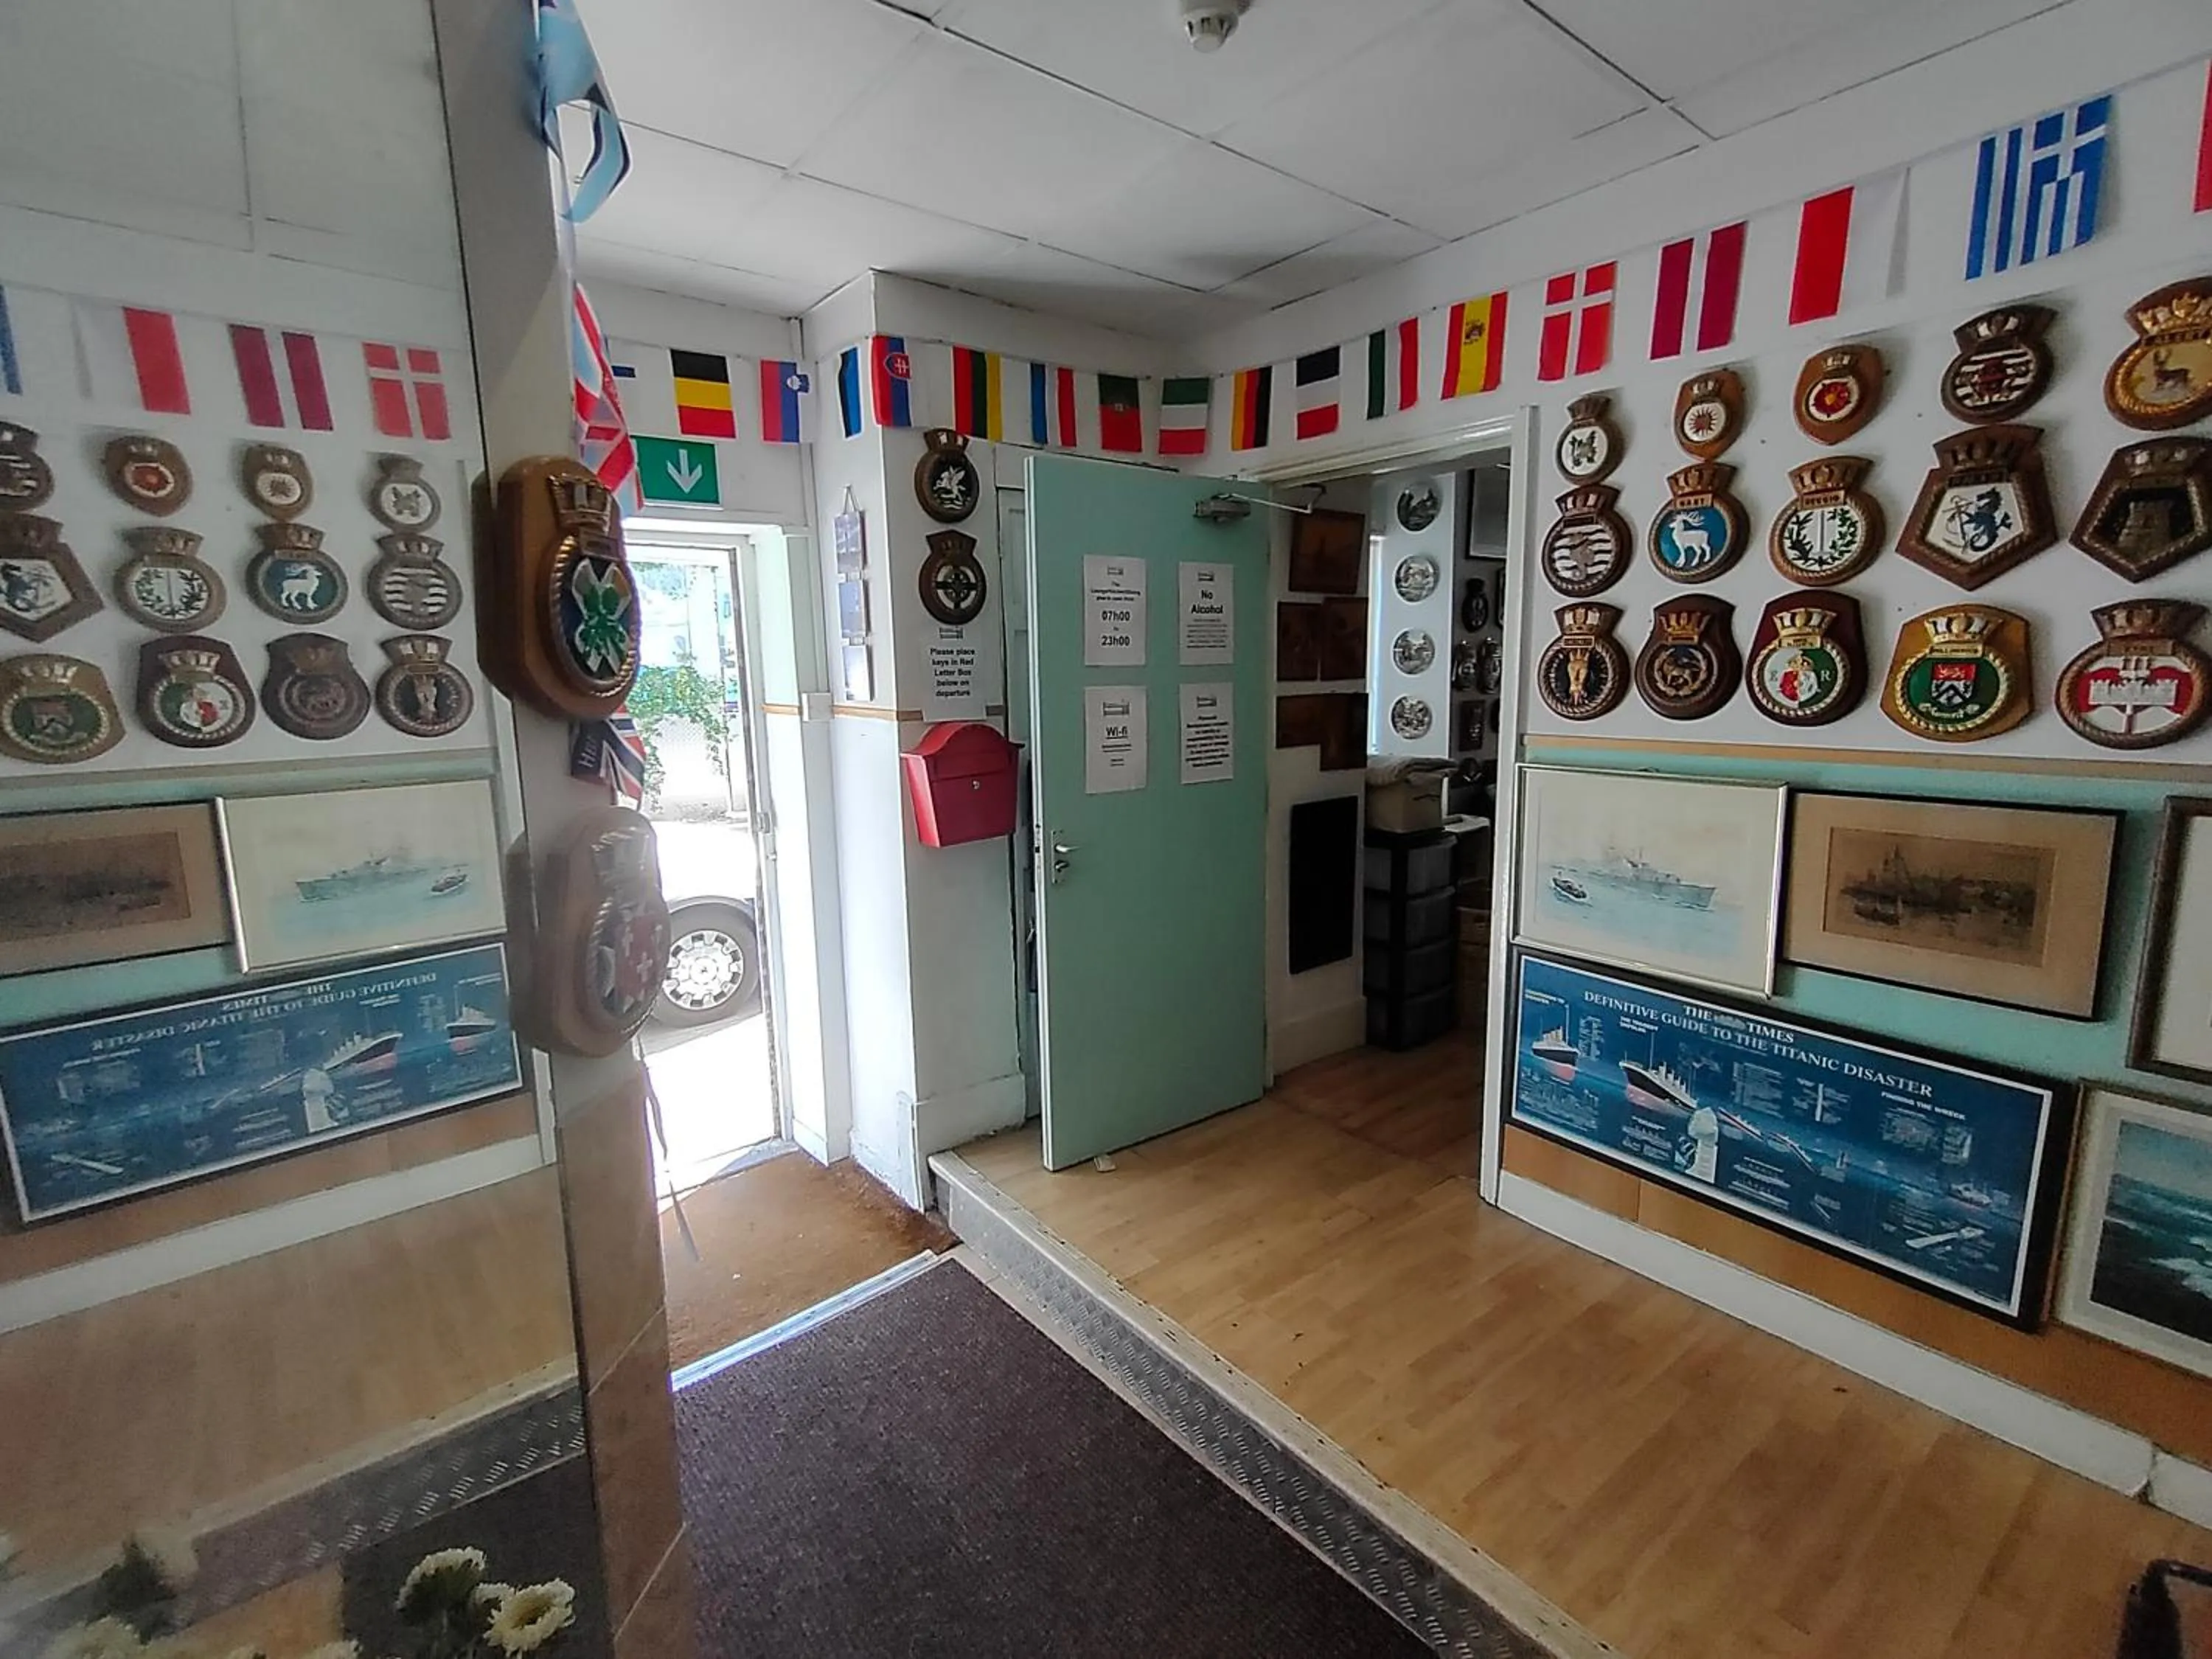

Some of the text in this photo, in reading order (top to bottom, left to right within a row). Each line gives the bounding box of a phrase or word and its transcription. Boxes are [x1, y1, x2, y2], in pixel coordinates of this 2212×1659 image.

[1201, 590, 1213, 599] No
[1192, 604, 1223, 614] Alcohol
[1102, 611, 1130, 621] 07h00
[1102, 636, 1130, 646] 23h00
[956, 648, 975, 656] place
[932, 658, 949, 667] keys
[960, 658, 974, 666] Red
[958, 668, 971, 676] Box
[936, 689, 970, 699] departure
[1683, 1005, 1794, 1043] THE TIMES
[1585, 990, 1658, 1020] DEFINITIVE
[1661, 1012, 1708, 1034] GUIDE
[1712, 1026, 1732, 1040] TO
[1734, 1032, 1768, 1051] THE
[1773, 1043, 1840, 1071] TITANIC
[1843, 1062, 1933, 1098] DISASTER
